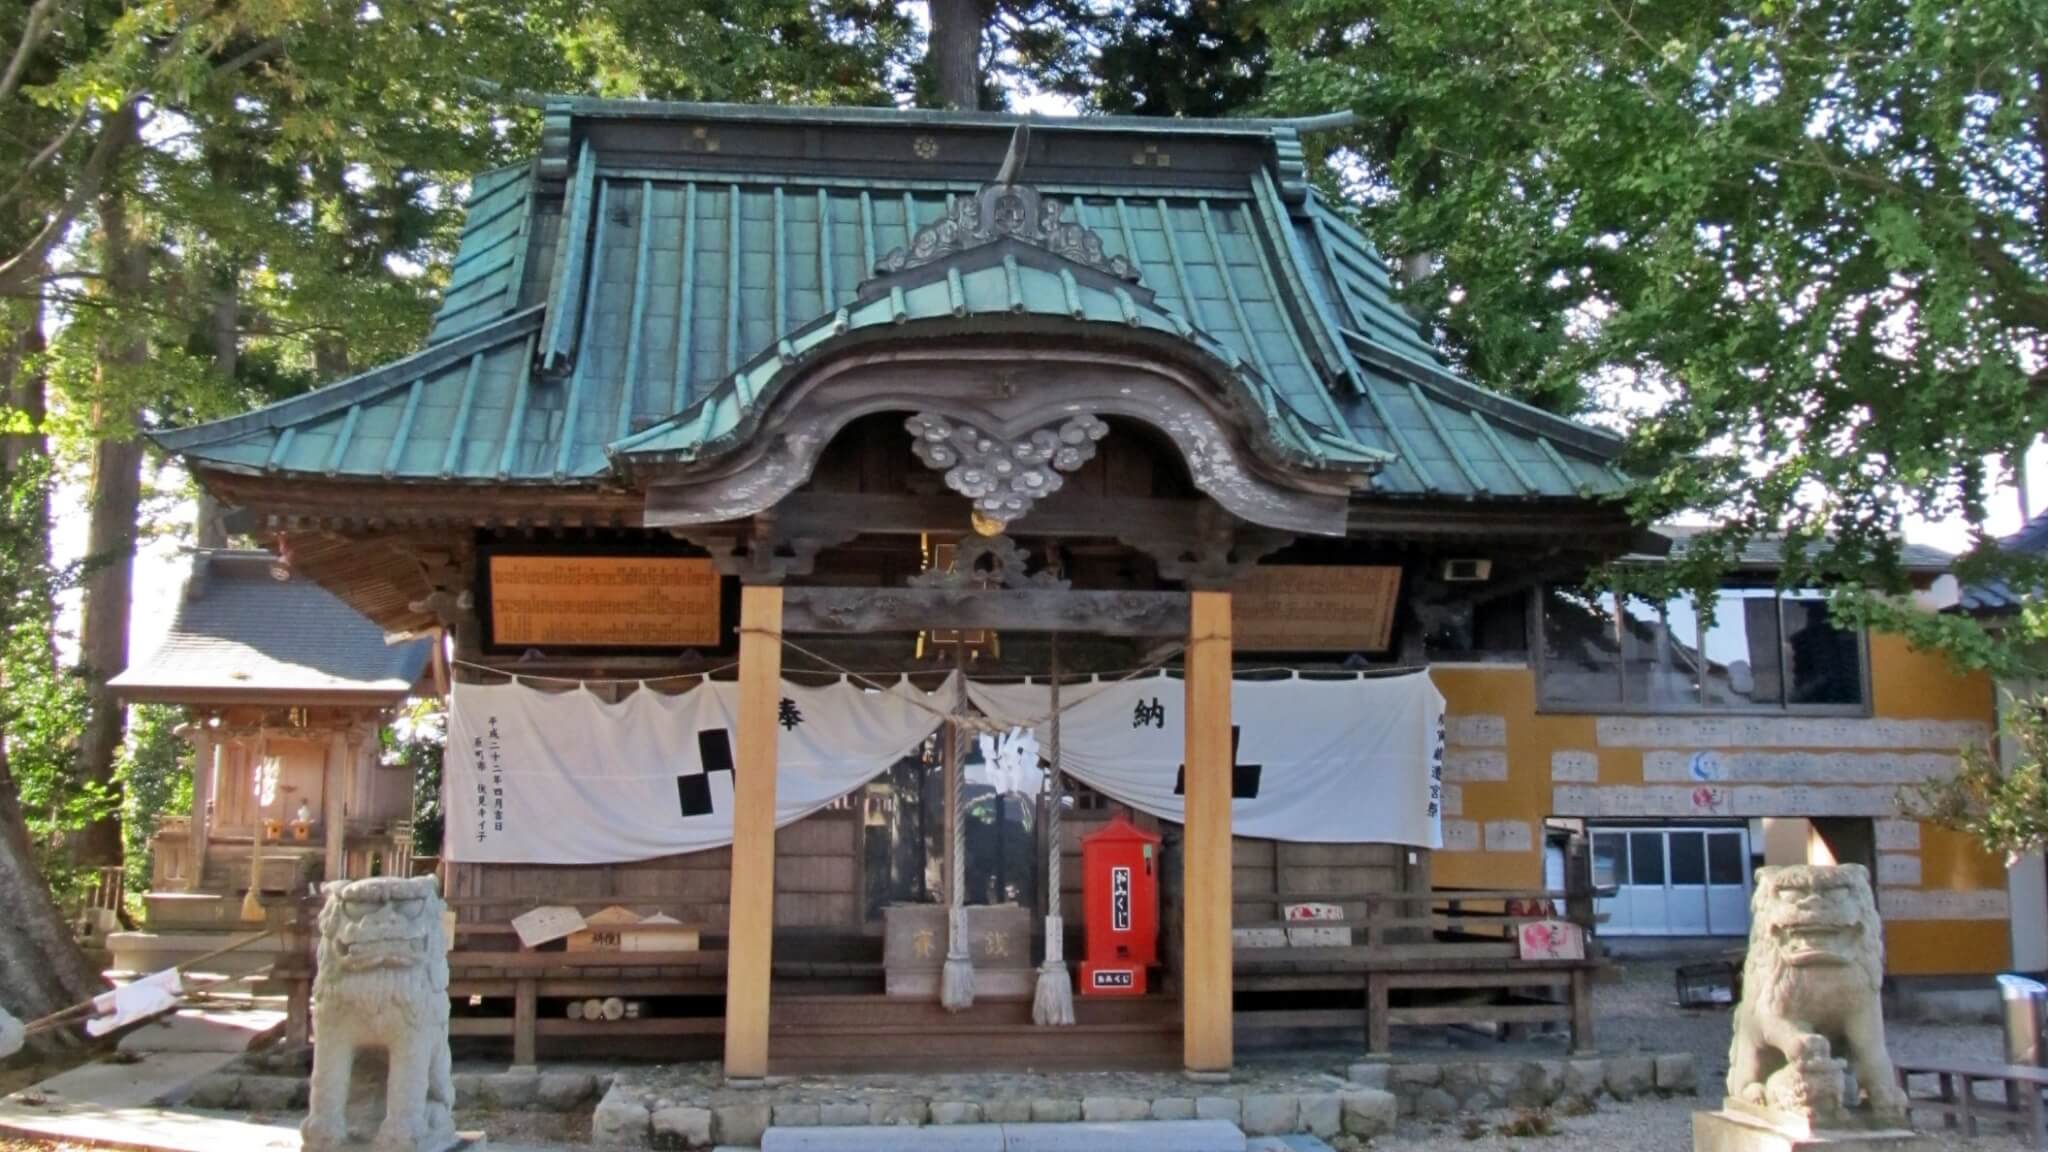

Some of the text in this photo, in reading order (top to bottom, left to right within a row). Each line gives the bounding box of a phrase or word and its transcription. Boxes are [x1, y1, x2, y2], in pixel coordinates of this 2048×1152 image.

[778, 696, 1164, 731] 奉 納
[1114, 871, 1128, 928] おみくじ
